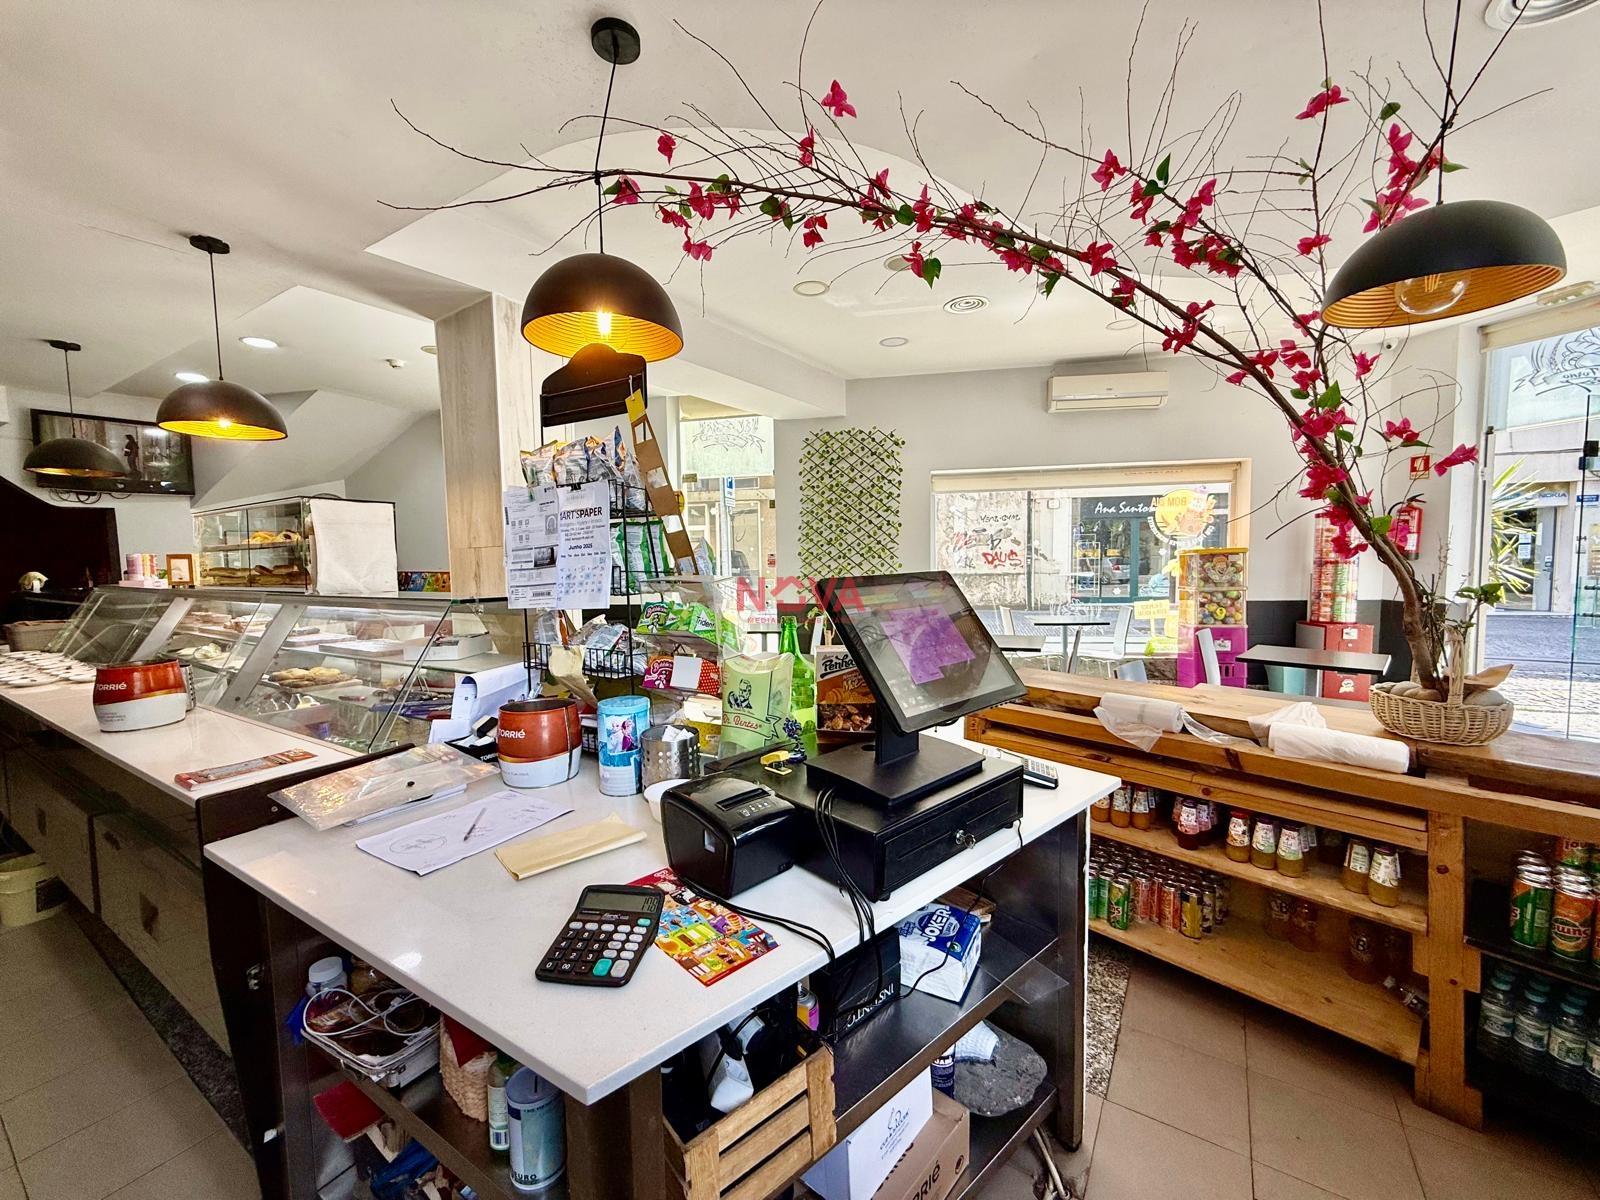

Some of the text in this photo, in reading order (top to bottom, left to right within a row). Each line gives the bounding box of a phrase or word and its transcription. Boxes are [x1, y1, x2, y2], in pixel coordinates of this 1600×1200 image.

[1094, 501, 1116, 514] Ana
[696, 616, 716, 628] Trident
[921, 904, 952, 943] JOKER
